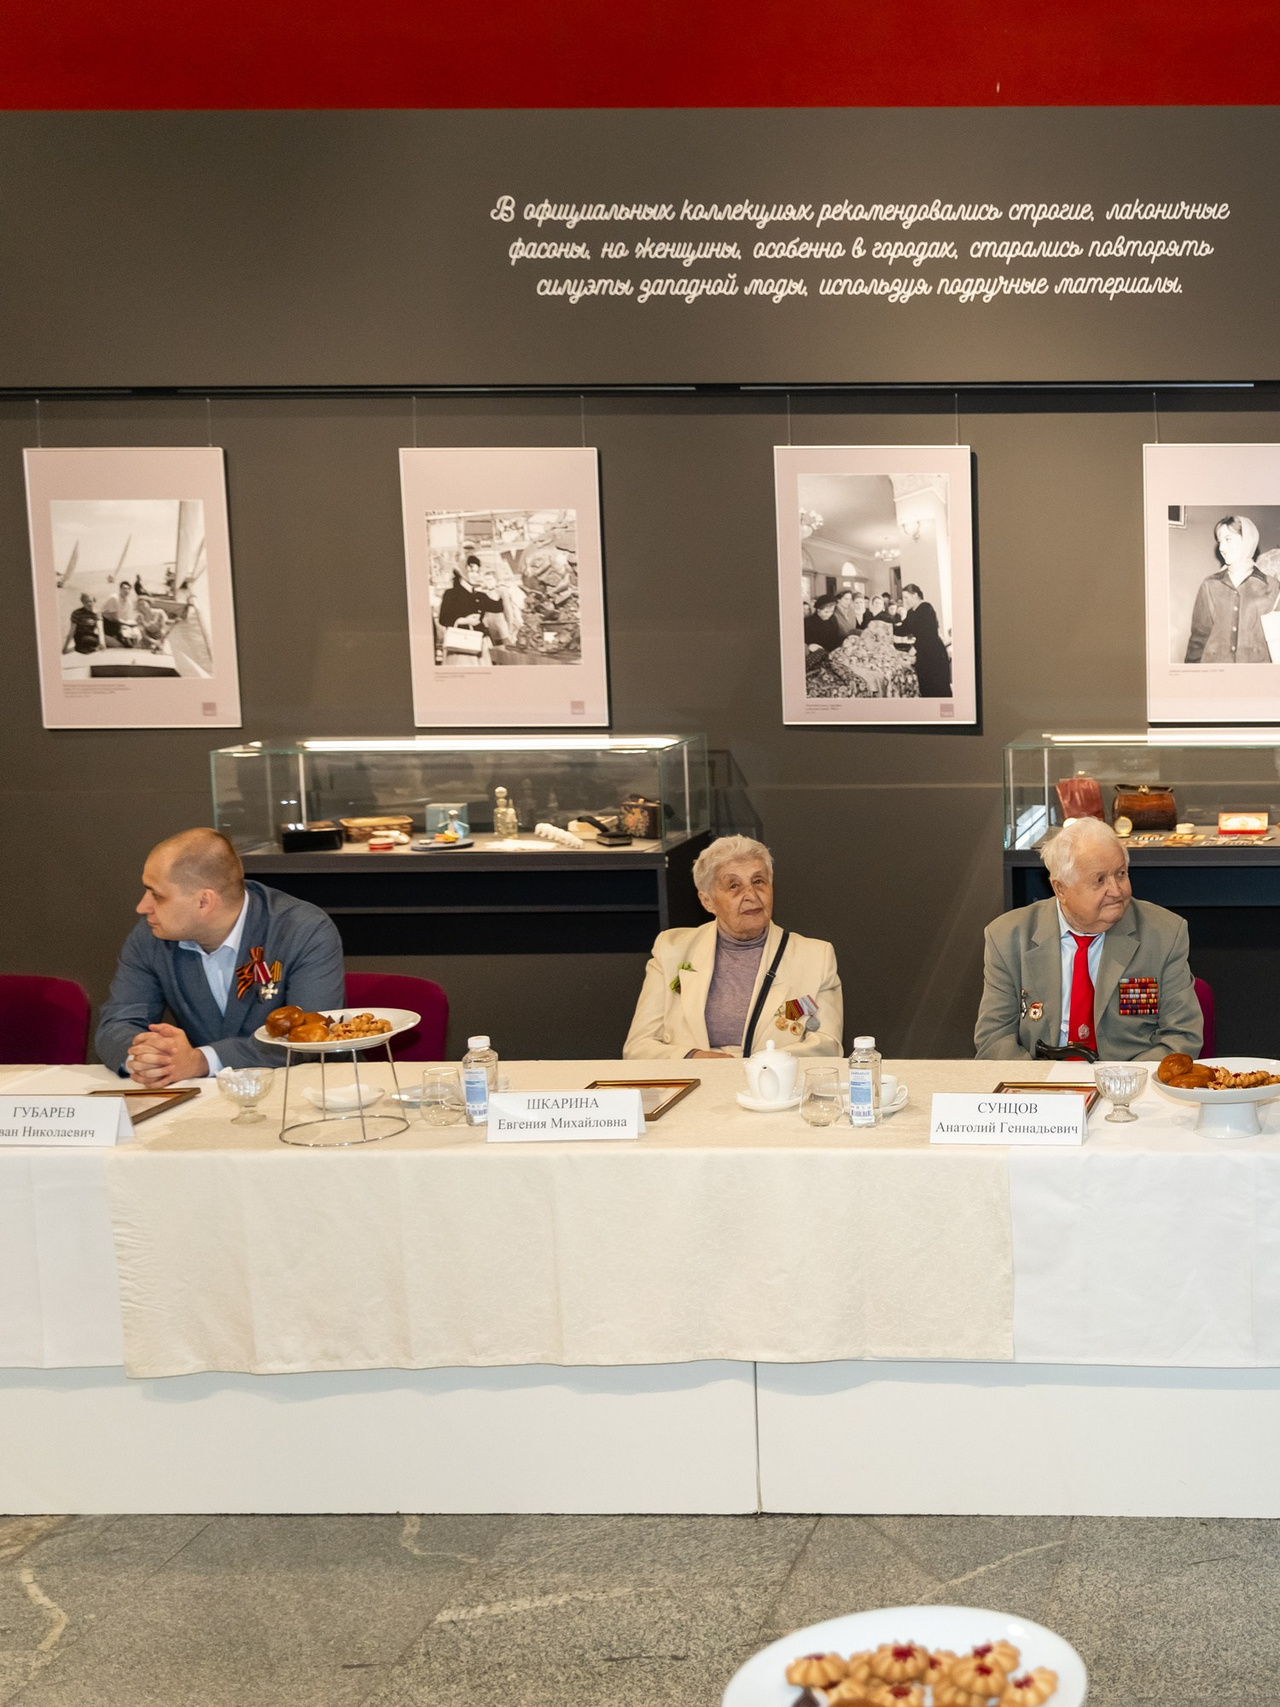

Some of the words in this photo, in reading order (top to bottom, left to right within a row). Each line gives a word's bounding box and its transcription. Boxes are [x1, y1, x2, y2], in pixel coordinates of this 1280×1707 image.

[490, 195, 515, 222] В
[524, 199, 676, 229] официальных
[680, 199, 815, 229] коллекциях
[816, 199, 1003, 229] рекомендовались
[1106, 198, 1230, 220] лаконичные
[601, 242, 629, 258] но
[753, 237, 846, 258] особенно
[852, 237, 866, 258] в
[970, 241, 1084, 265] старались
[1088, 235, 1214, 264] повторять
[537, 279, 634, 304] силуэты
[637, 273, 739, 304] западной
[819, 278, 933, 303] используя
[937, 276, 1049, 303] подручные
[1054, 277, 1182, 301] материалы.
[527, 1097, 600, 1110] ШКАРИНА
[977, 1101, 1038, 1116] СУНЦОВ
[12, 1106, 76, 1118] ГУБАРЕВ
[497, 1118, 547, 1130] Евгения
[550, 1116, 628, 1129] Михайловна
[935, 1121, 996, 1133] Анатолий
[999, 1121, 1078, 1135] Геннадьевич
[0, 1128, 19, 1137] ван
[22, 1125, 95, 1138] Николаевич
